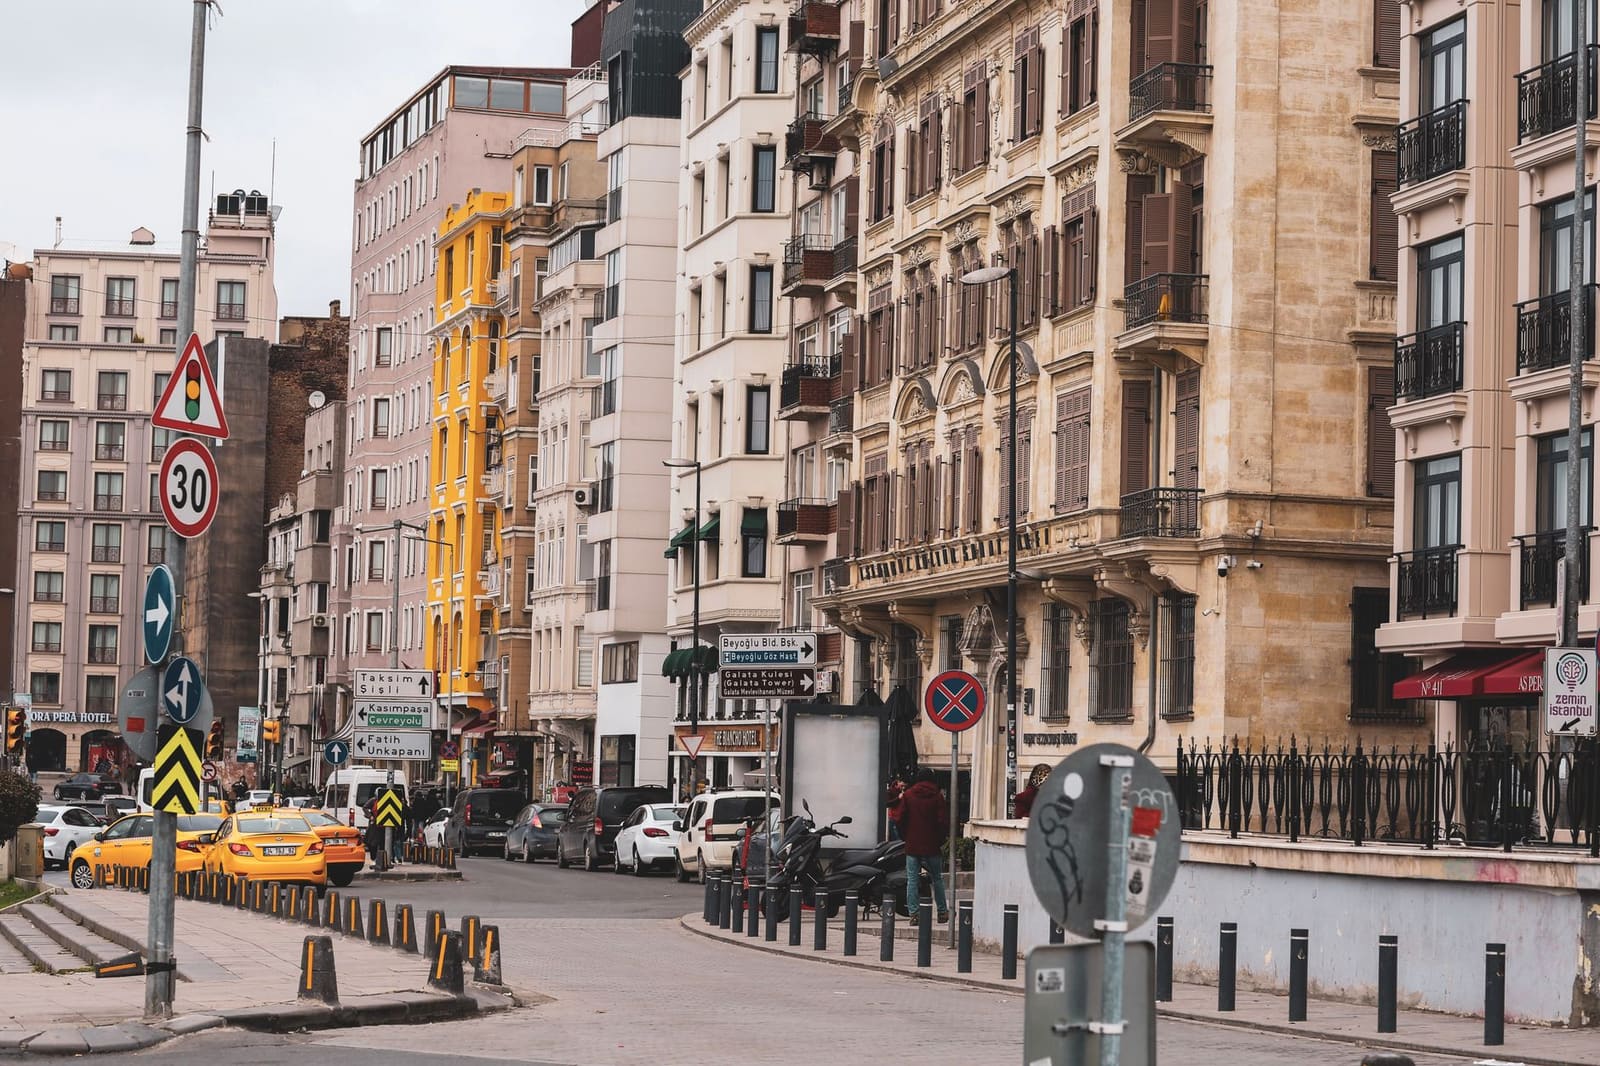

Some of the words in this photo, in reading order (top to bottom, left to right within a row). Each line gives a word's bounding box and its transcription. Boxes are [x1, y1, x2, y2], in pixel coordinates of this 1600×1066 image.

[171, 464, 207, 513] 30
[724, 638, 759, 649] Beyoğlu
[762, 638, 778, 647] Bld.
[781, 638, 798, 648] Bşk.
[731, 652, 761, 662] Beyoğlu
[361, 673, 413, 683] Taksim
[723, 679, 759, 688] (Galata
[762, 679, 794, 688] Tower)
[1518, 675, 1544, 691] ASPER
[360, 684, 399, 694] Şişli
[1555, 695, 1587, 704] zemin
[369, 703, 429, 714] Kasımpaşa
[1549, 704, 1592, 716] istanbul
[31, 711, 50, 722] ORA
[53, 711, 77, 722] PERA
[80, 712, 112, 723] HOTEL
[369, 715, 422, 727] Çevreyolu
[368, 734, 401, 744] Fatih
[367, 746, 425, 757] Unkapanı
